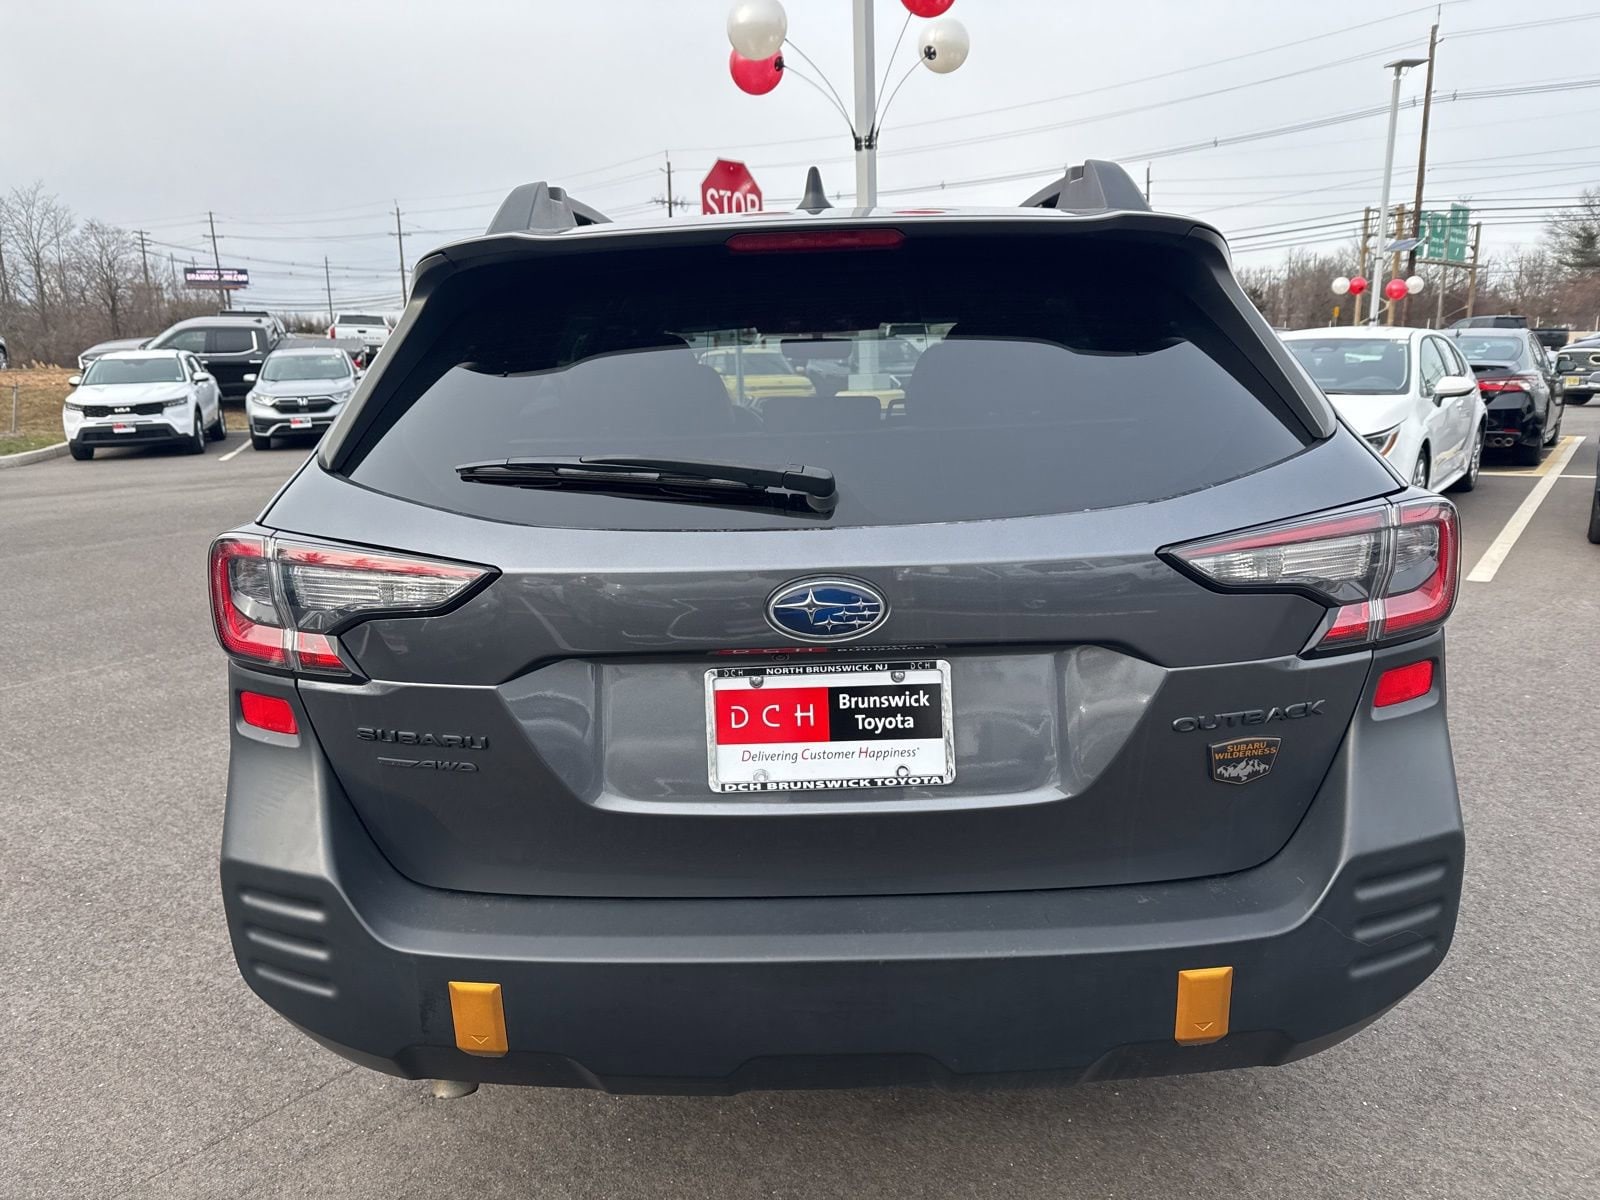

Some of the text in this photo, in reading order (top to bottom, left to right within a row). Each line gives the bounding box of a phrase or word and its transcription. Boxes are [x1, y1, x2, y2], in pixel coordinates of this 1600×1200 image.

[706, 187, 760, 214] STOP
[766, 667, 804, 675] NORTH
[839, 690, 930, 709] Brunswick
[1172, 699, 1325, 732] OUTBACK
[855, 713, 914, 734] Toyota
[357, 727, 489, 749] SUBARU
[1215, 746, 1277, 760] WILDERNESS
[1227, 741, 1267, 752] SUBARU
[741, 750, 798, 763] Delivering
[801, 748, 855, 761] Customer
[414, 760, 479, 771] AWD
[724, 776, 943, 791] DCH BRUNSWICK TOYOTA
